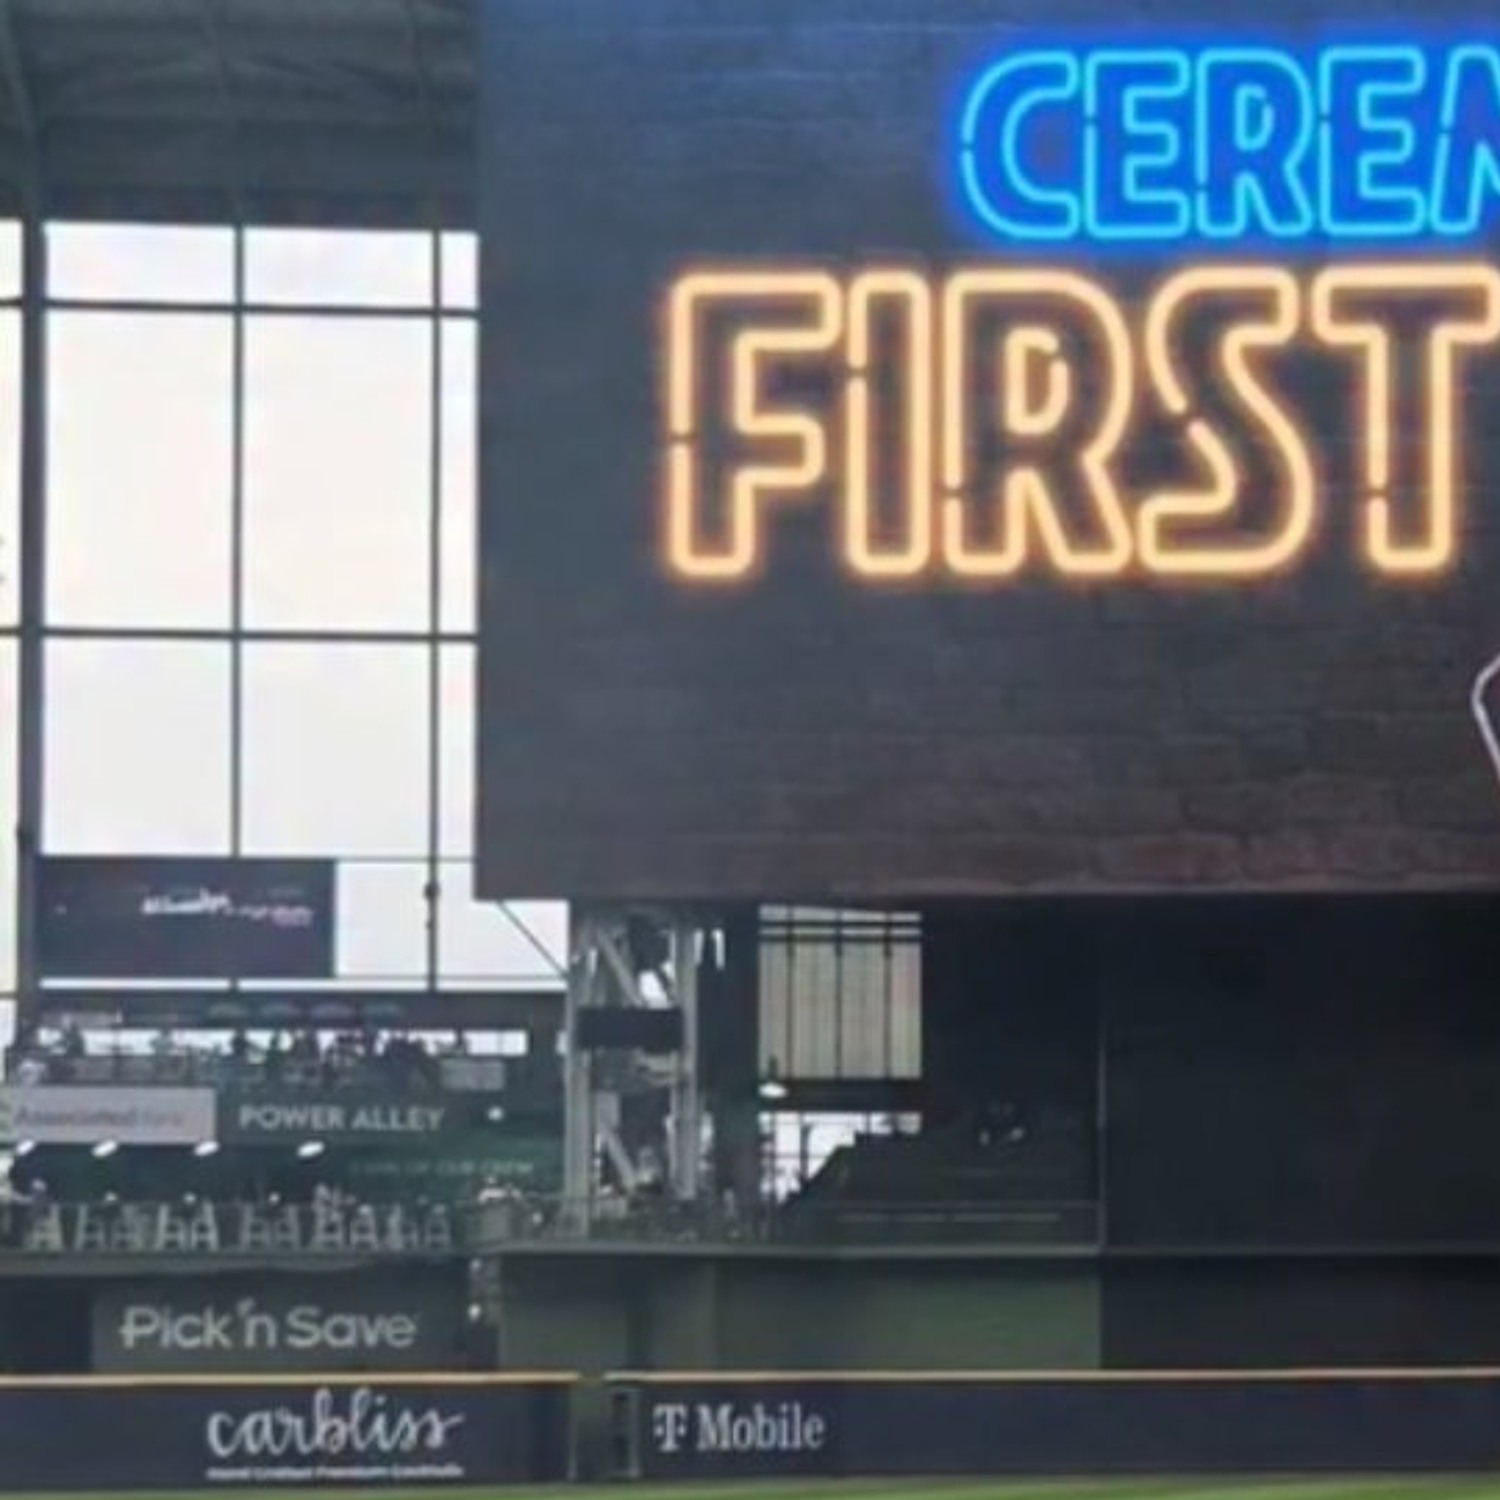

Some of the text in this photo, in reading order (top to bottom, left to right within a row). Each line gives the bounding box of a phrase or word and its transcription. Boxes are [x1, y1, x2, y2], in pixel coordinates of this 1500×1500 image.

[239, 1107, 445, 1131] POWER ALLEY
[119, 1304, 232, 1349] Pick
[286, 1305, 417, 1349] Save
[207, 1388, 464, 1457] carbliss
